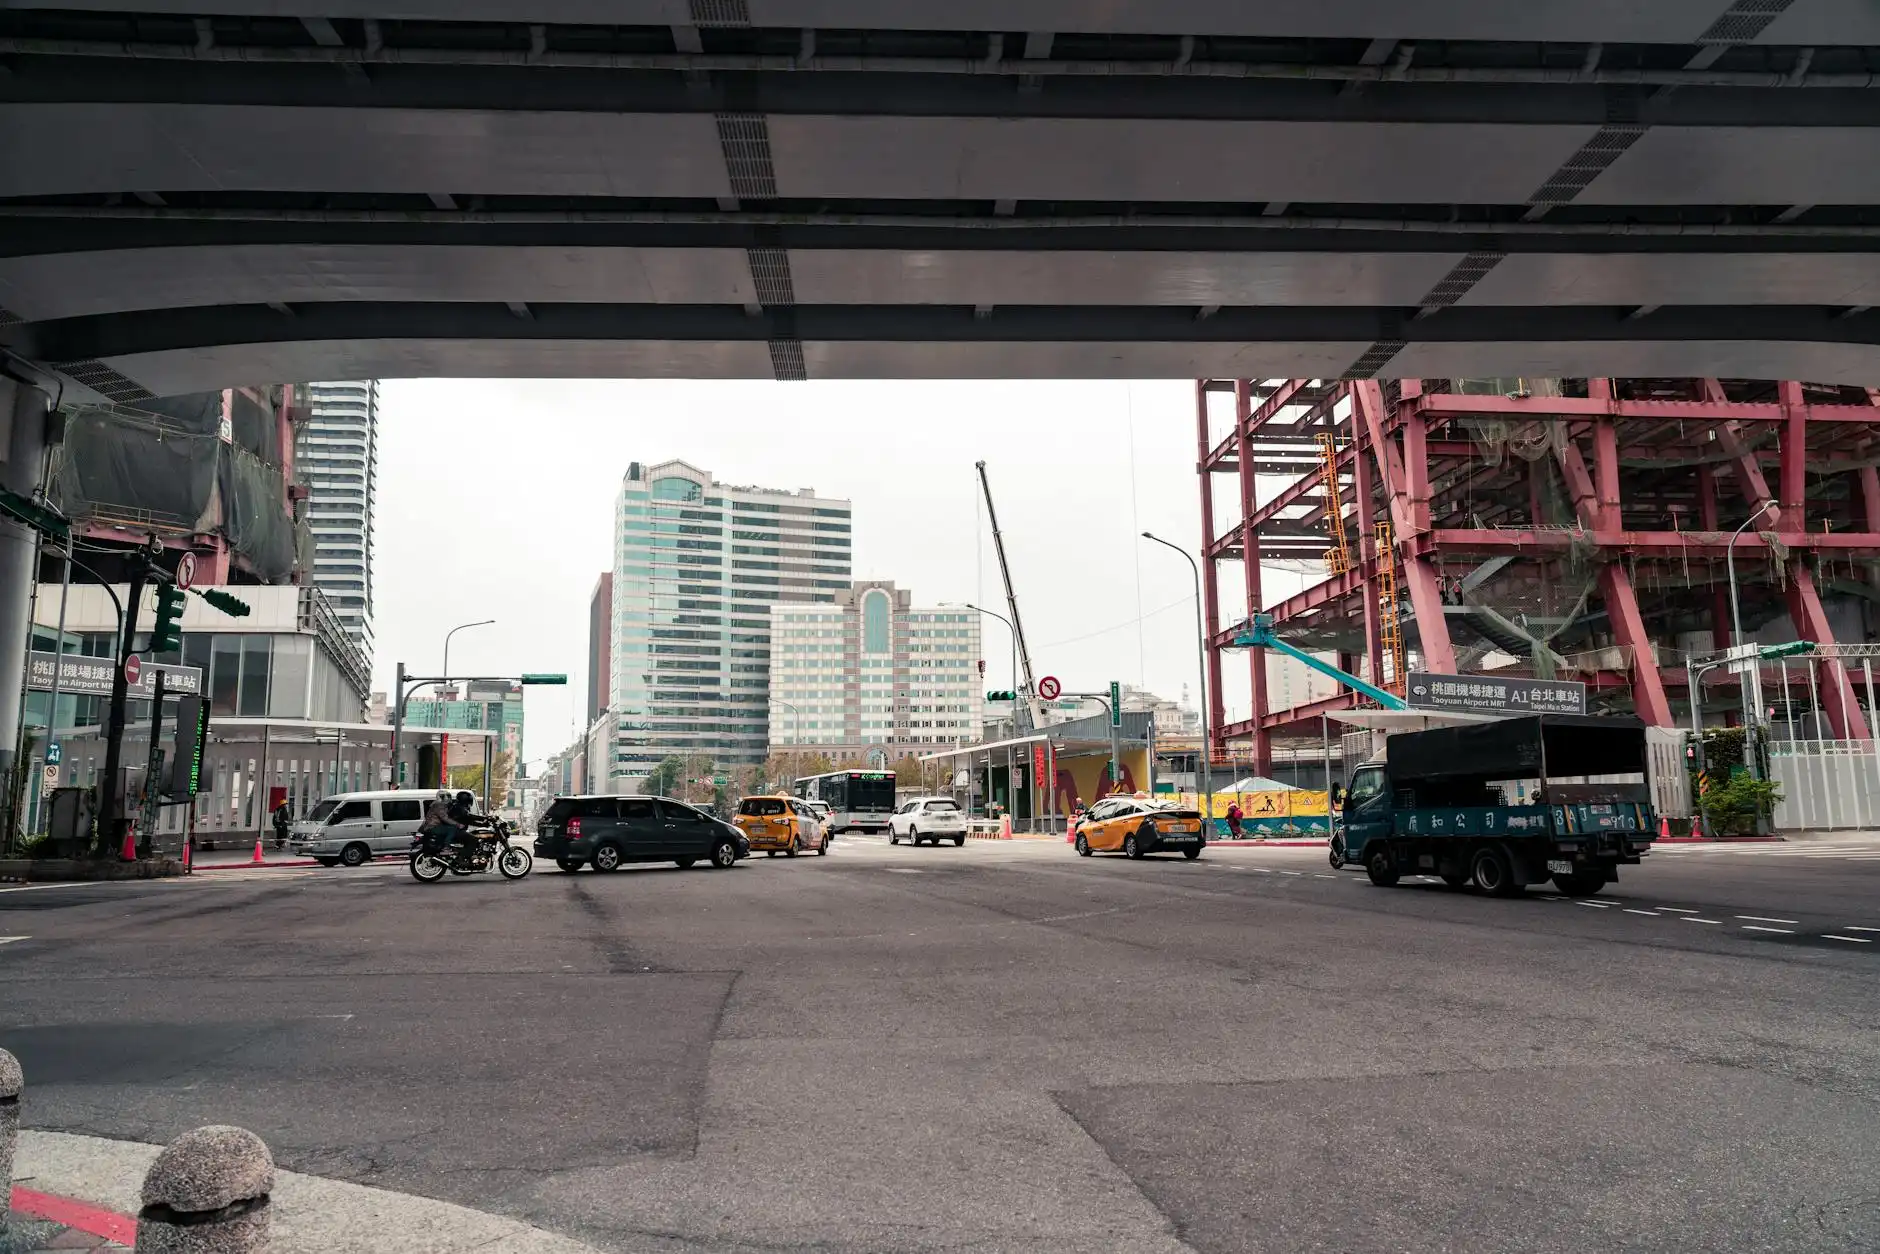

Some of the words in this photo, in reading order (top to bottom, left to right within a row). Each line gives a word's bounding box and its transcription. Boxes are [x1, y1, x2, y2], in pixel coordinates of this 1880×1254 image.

[32, 675, 68, 687] Taoyan
[70, 679, 99, 689] Airport
[101, 682, 114, 690] MR
[1431, 681, 1506, 699] 桃園機場捷運
[1511, 690, 1528, 703] A1
[1531, 688, 1580, 704] 台北車站
[1431, 696, 1462, 706] Taoyuan
[1463, 698, 1489, 708] Airport
[1490, 700, 1506, 708] MRT
